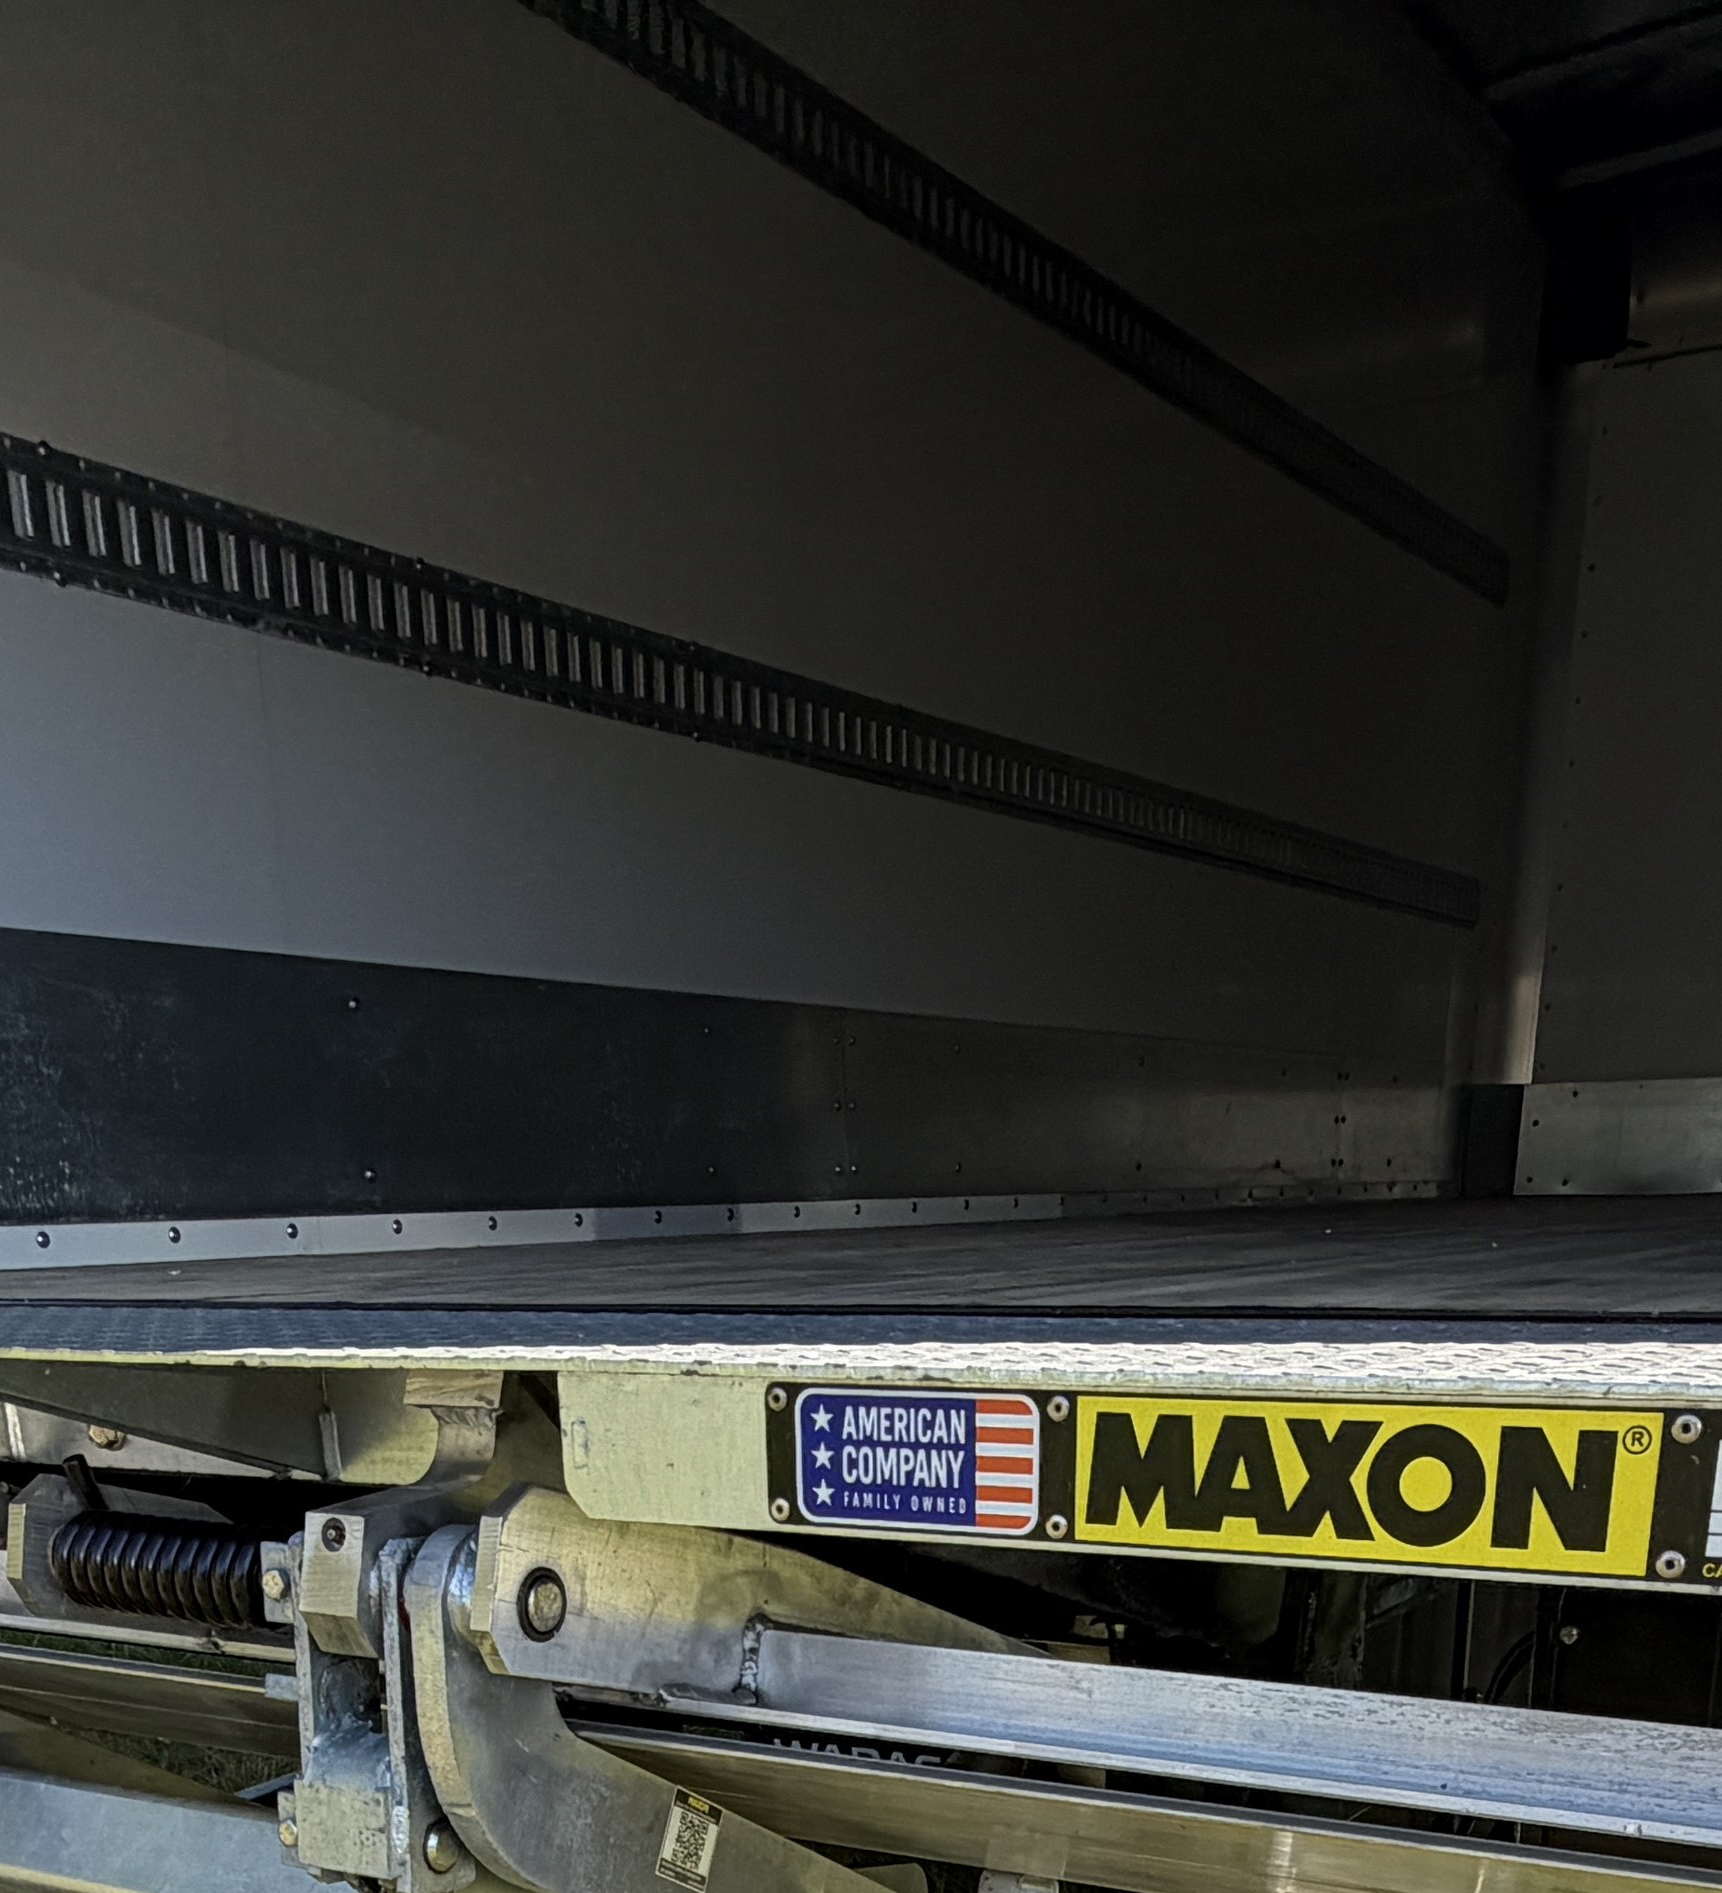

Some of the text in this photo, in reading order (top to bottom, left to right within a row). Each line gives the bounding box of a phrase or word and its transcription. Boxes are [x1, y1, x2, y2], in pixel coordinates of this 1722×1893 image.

[841, 1405, 966, 1445] AMERICAN
[841, 1445, 965, 1489] COMPANY
[843, 1491, 967, 1514] FAMILY OWNED
